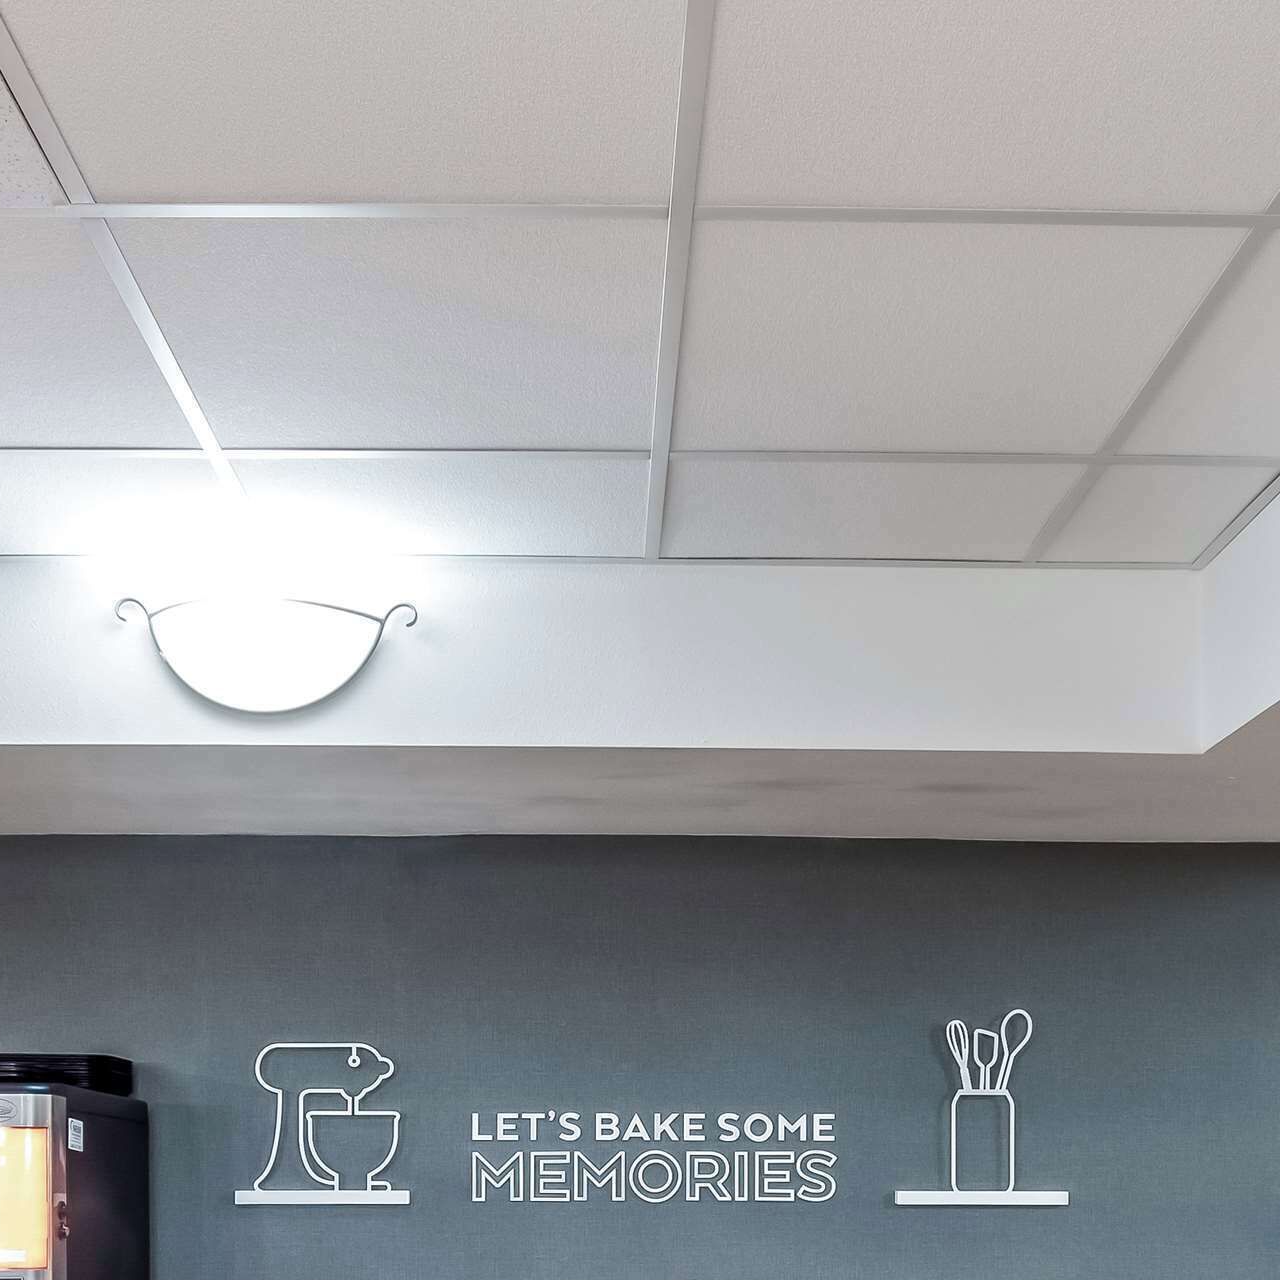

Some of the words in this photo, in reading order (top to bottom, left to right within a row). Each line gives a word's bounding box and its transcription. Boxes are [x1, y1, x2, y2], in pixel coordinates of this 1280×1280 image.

[471, 1110, 582, 1142] LET'S
[595, 1112, 706, 1142] BAKE
[718, 1112, 836, 1142] SOME
[471, 1150, 838, 1204] MEMORIES
